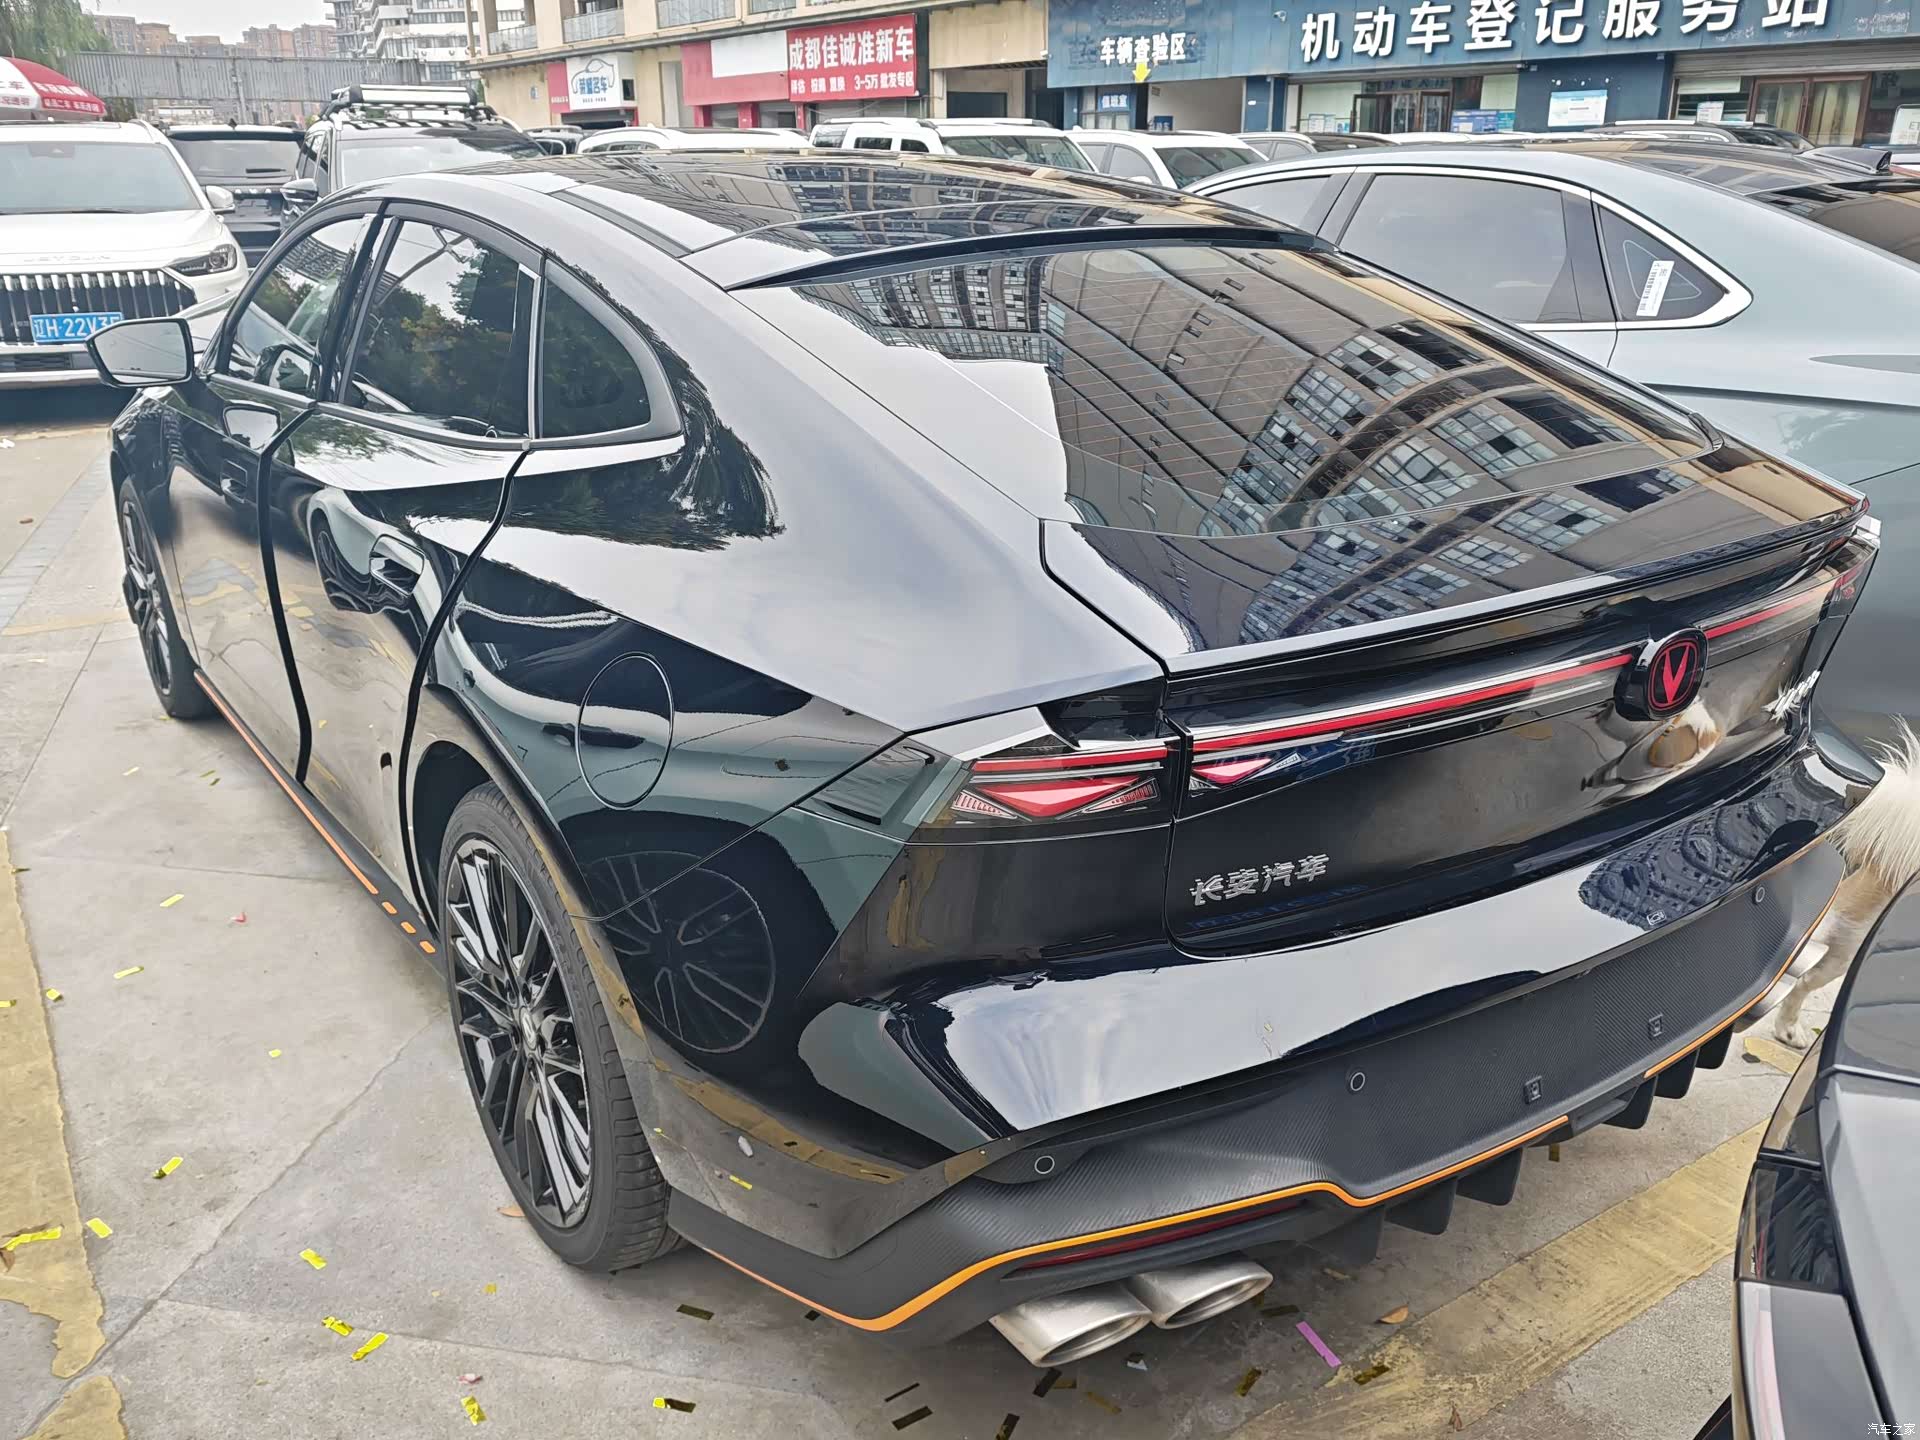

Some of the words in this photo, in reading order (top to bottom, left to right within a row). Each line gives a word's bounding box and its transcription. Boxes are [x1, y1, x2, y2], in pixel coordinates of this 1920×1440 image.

[789, 26, 914, 70] 成都佳诚准新车
[1100, 31, 1186, 65] 车辆查验区
[1189, 853, 1330, 906] 长安汽车
